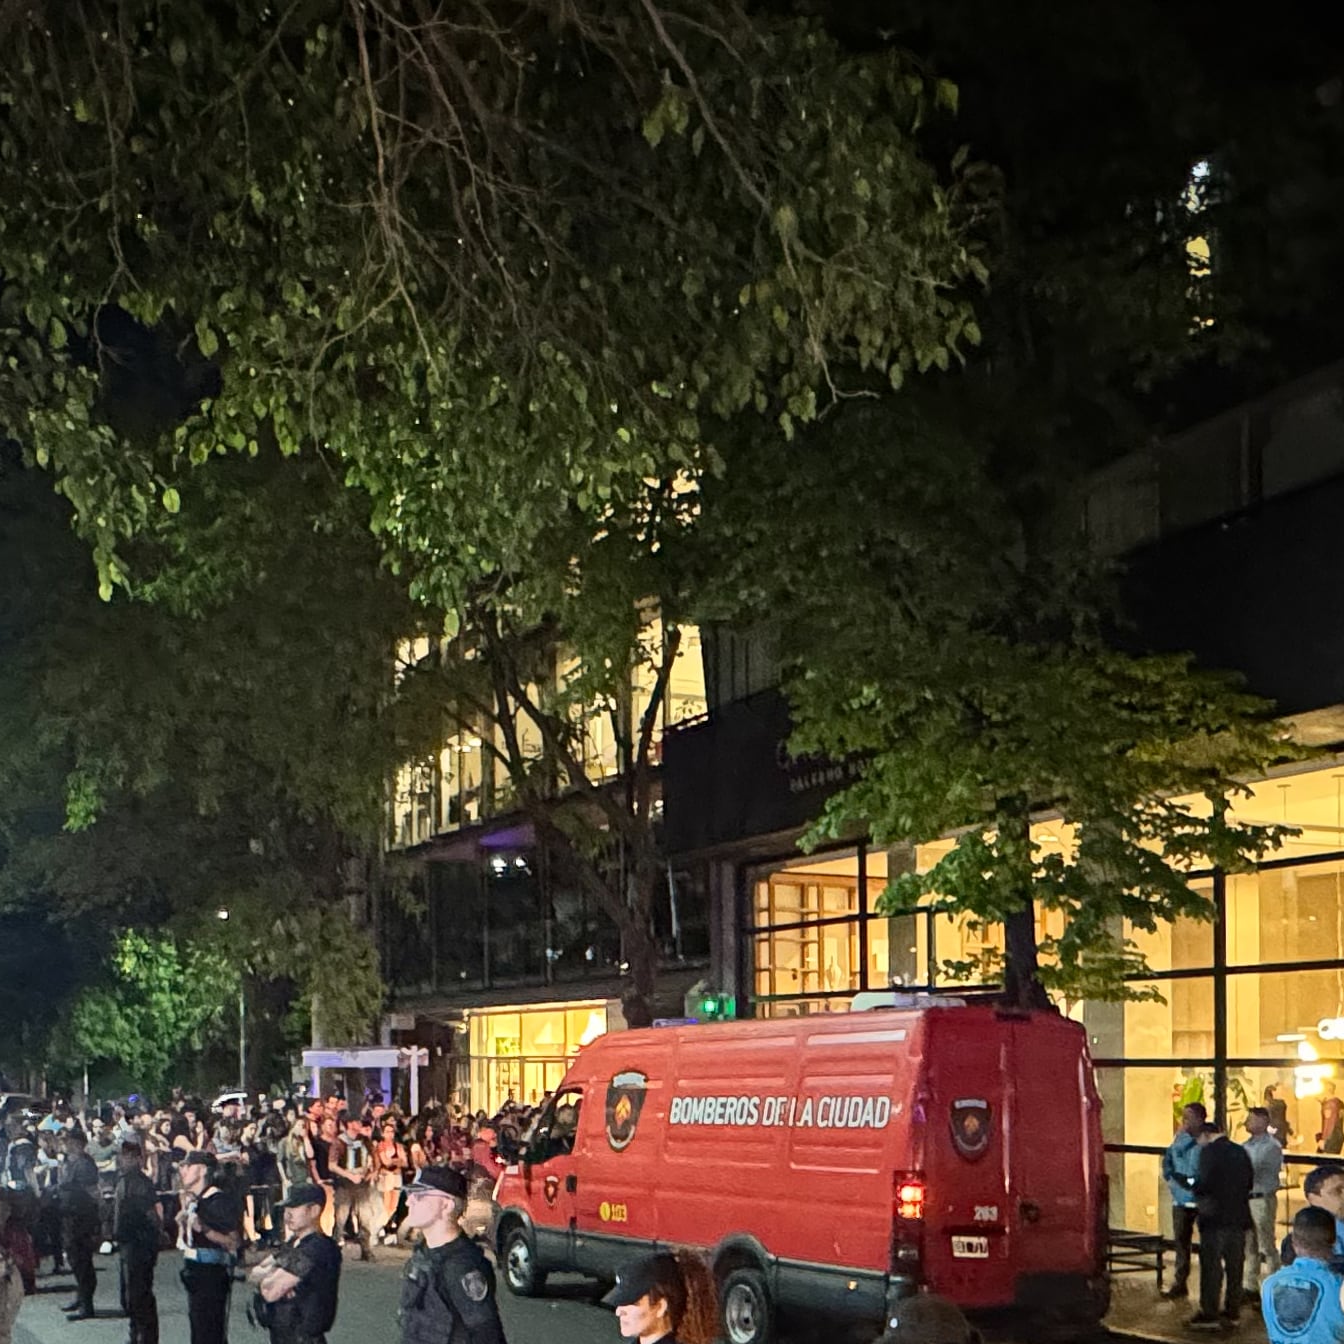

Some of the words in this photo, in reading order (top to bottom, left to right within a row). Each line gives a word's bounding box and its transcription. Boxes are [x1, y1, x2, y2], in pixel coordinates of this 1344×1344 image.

[670, 1097, 759, 1125] BOMBEROS
[762, 1097, 787, 1127] DE
[789, 1097, 813, 1127] LA
[817, 1096, 890, 1128] CIUDAD
